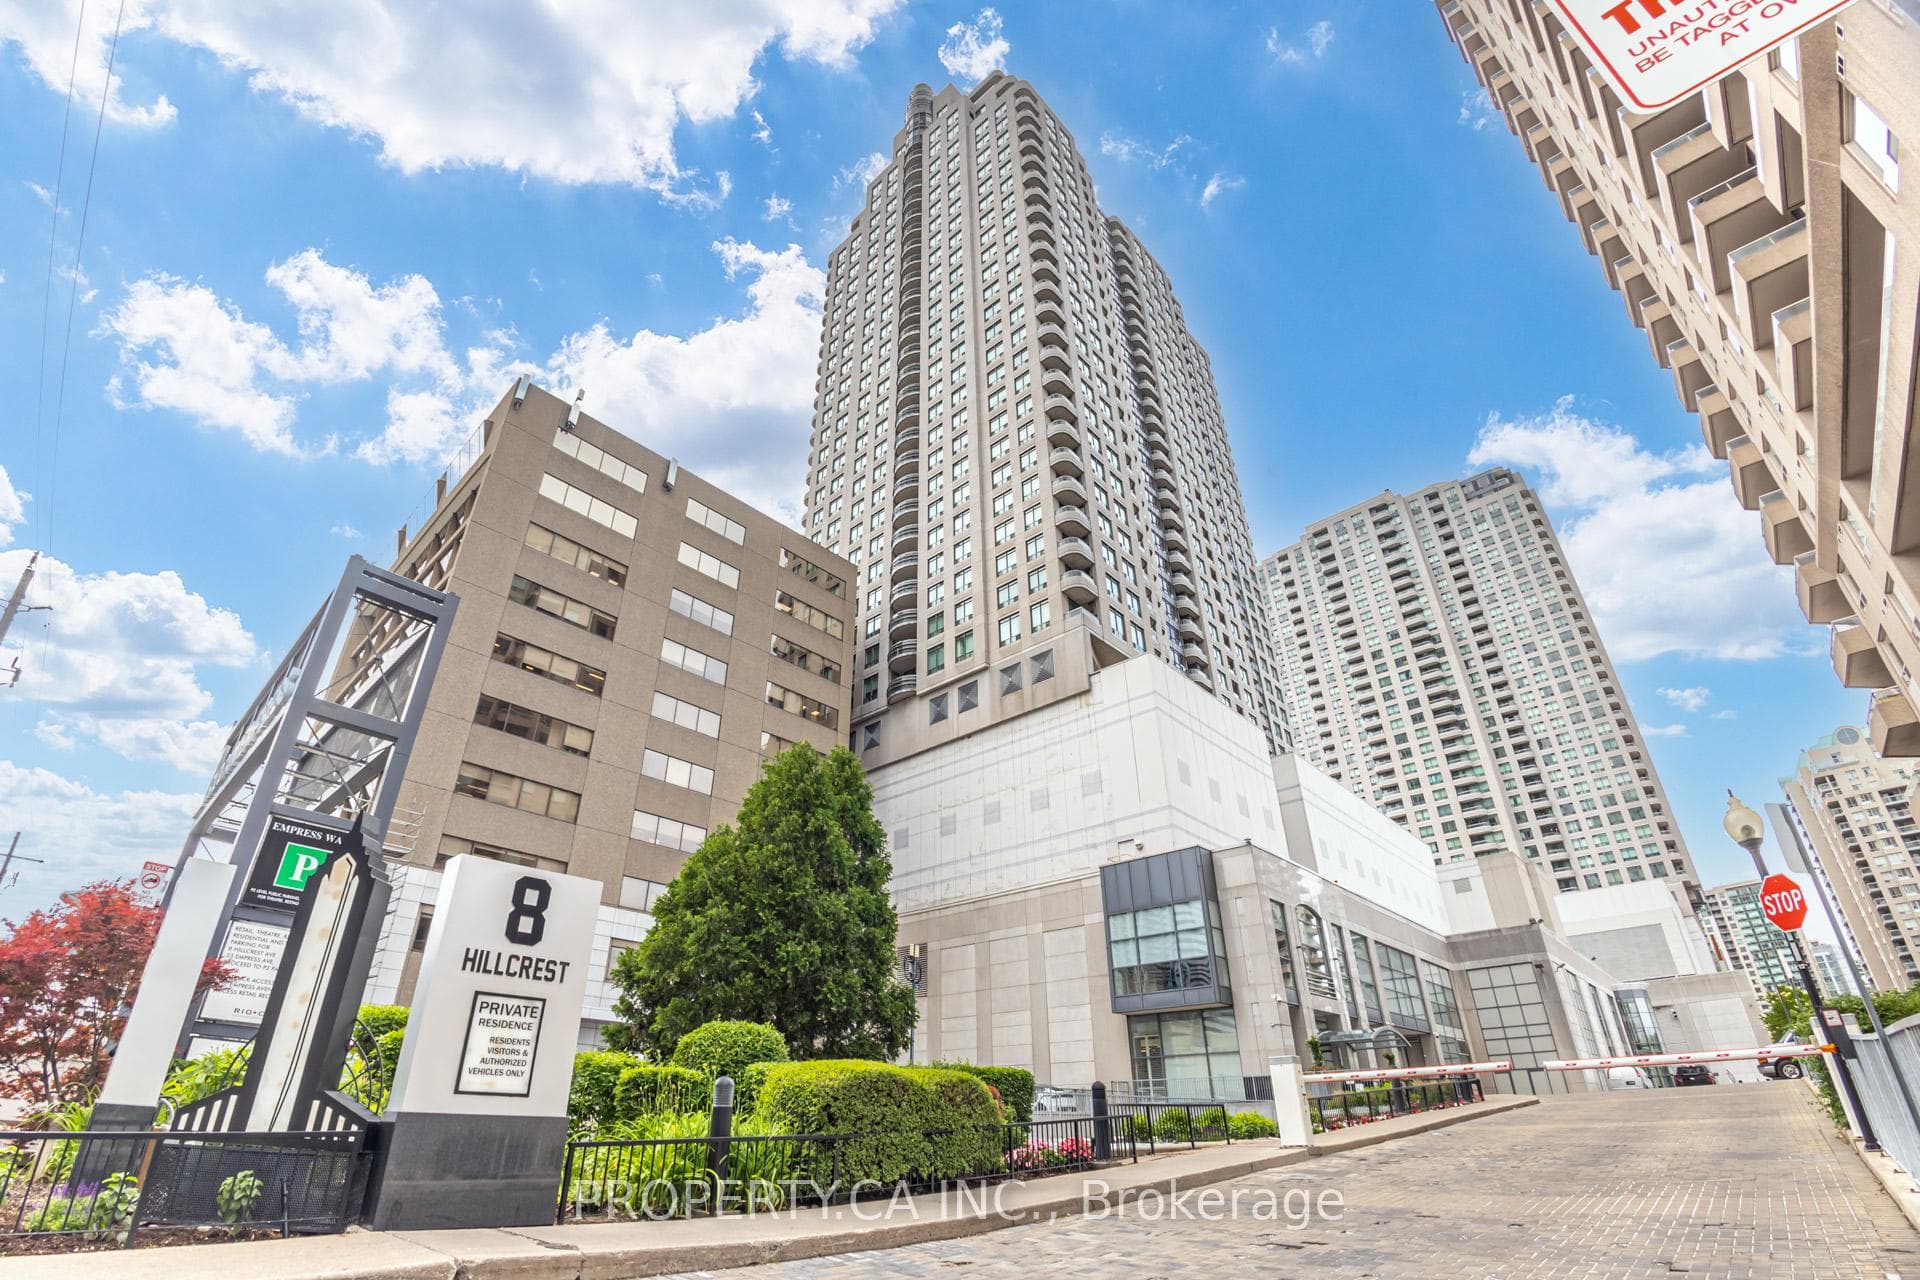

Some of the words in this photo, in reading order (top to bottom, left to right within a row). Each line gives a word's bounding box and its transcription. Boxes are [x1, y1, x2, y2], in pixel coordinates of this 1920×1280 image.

[1627, 0, 1729, 57] UNAUT
[1720, 18, 1749, 46] AT
[1760, 0, 1797, 19] O
[1635, 46, 1673, 74] BE
[272, 821, 323, 841] EMPRESS
[145, 863, 168, 873] STOP
[288, 853, 319, 882] P
[1764, 888, 1802, 916] STOP
[505, 876, 552, 947] 8
[230, 939, 257, 948] PARKING
[233, 933, 269, 943] RESIDENTIAL
[234, 947, 264, 956] HILLCREST
[235, 954, 260, 963] EMPRESS
[461, 947, 570, 984] HILLCREST
[478, 1000, 540, 1019] PRIVATE
[478, 1017, 534, 1031] RESIDENCE
[489, 1036, 531, 1046] RESIDENTS
[487, 1046, 521, 1056] VISITORS
[522, 1049, 529, 1057] &
[479, 1057, 527, 1067] AUTHORIZED
[468, 1066, 504, 1077] VEHICLES
[505, 1068, 526, 1078] ONLY
